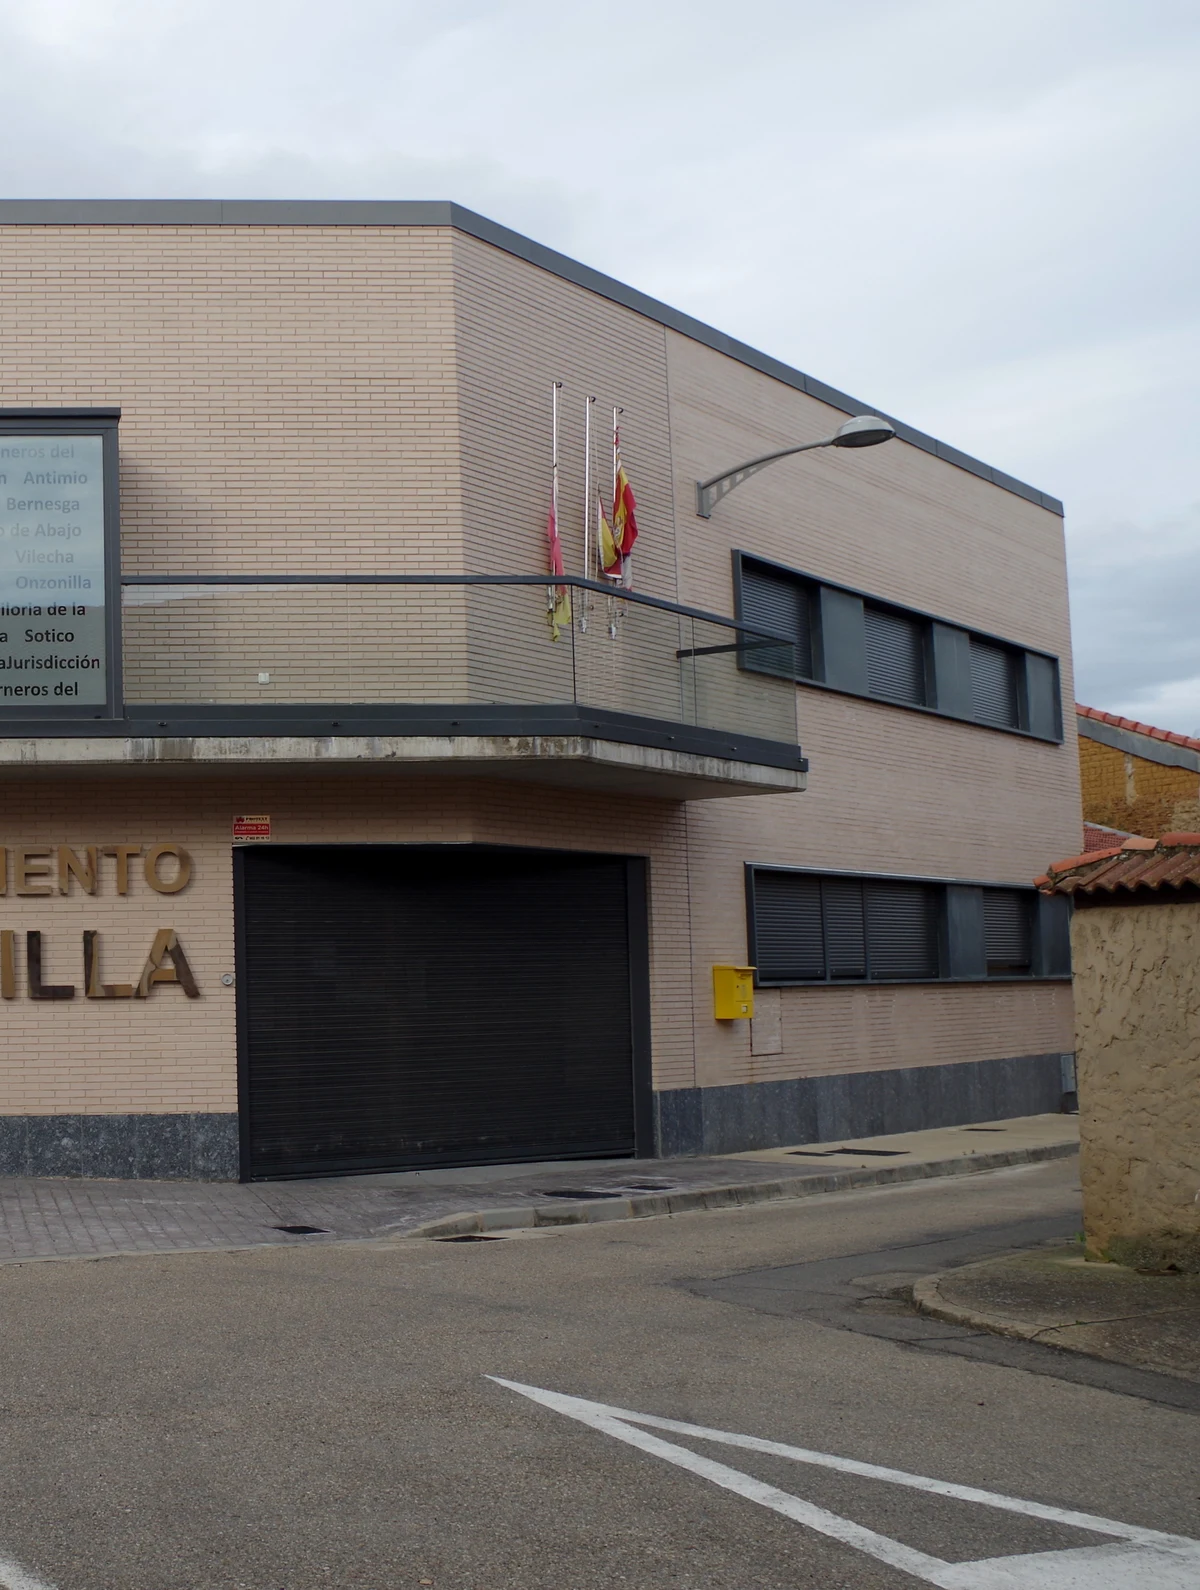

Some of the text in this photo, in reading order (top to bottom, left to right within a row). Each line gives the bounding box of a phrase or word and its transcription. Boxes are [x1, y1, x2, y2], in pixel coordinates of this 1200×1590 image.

[24, 471, 87, 485] Antimio
[6, 497, 80, 513] Bernesga
[10, 523, 30, 537] de
[34, 523, 82, 540] Abajo
[15, 550, 74, 564] Vilecha
[15, 575, 91, 590] Onzonilla
[47, 602, 67, 616] de
[72, 602, 86, 616] la
[24, 628, 75, 643] Sotico
[54, 682, 78, 696] del
